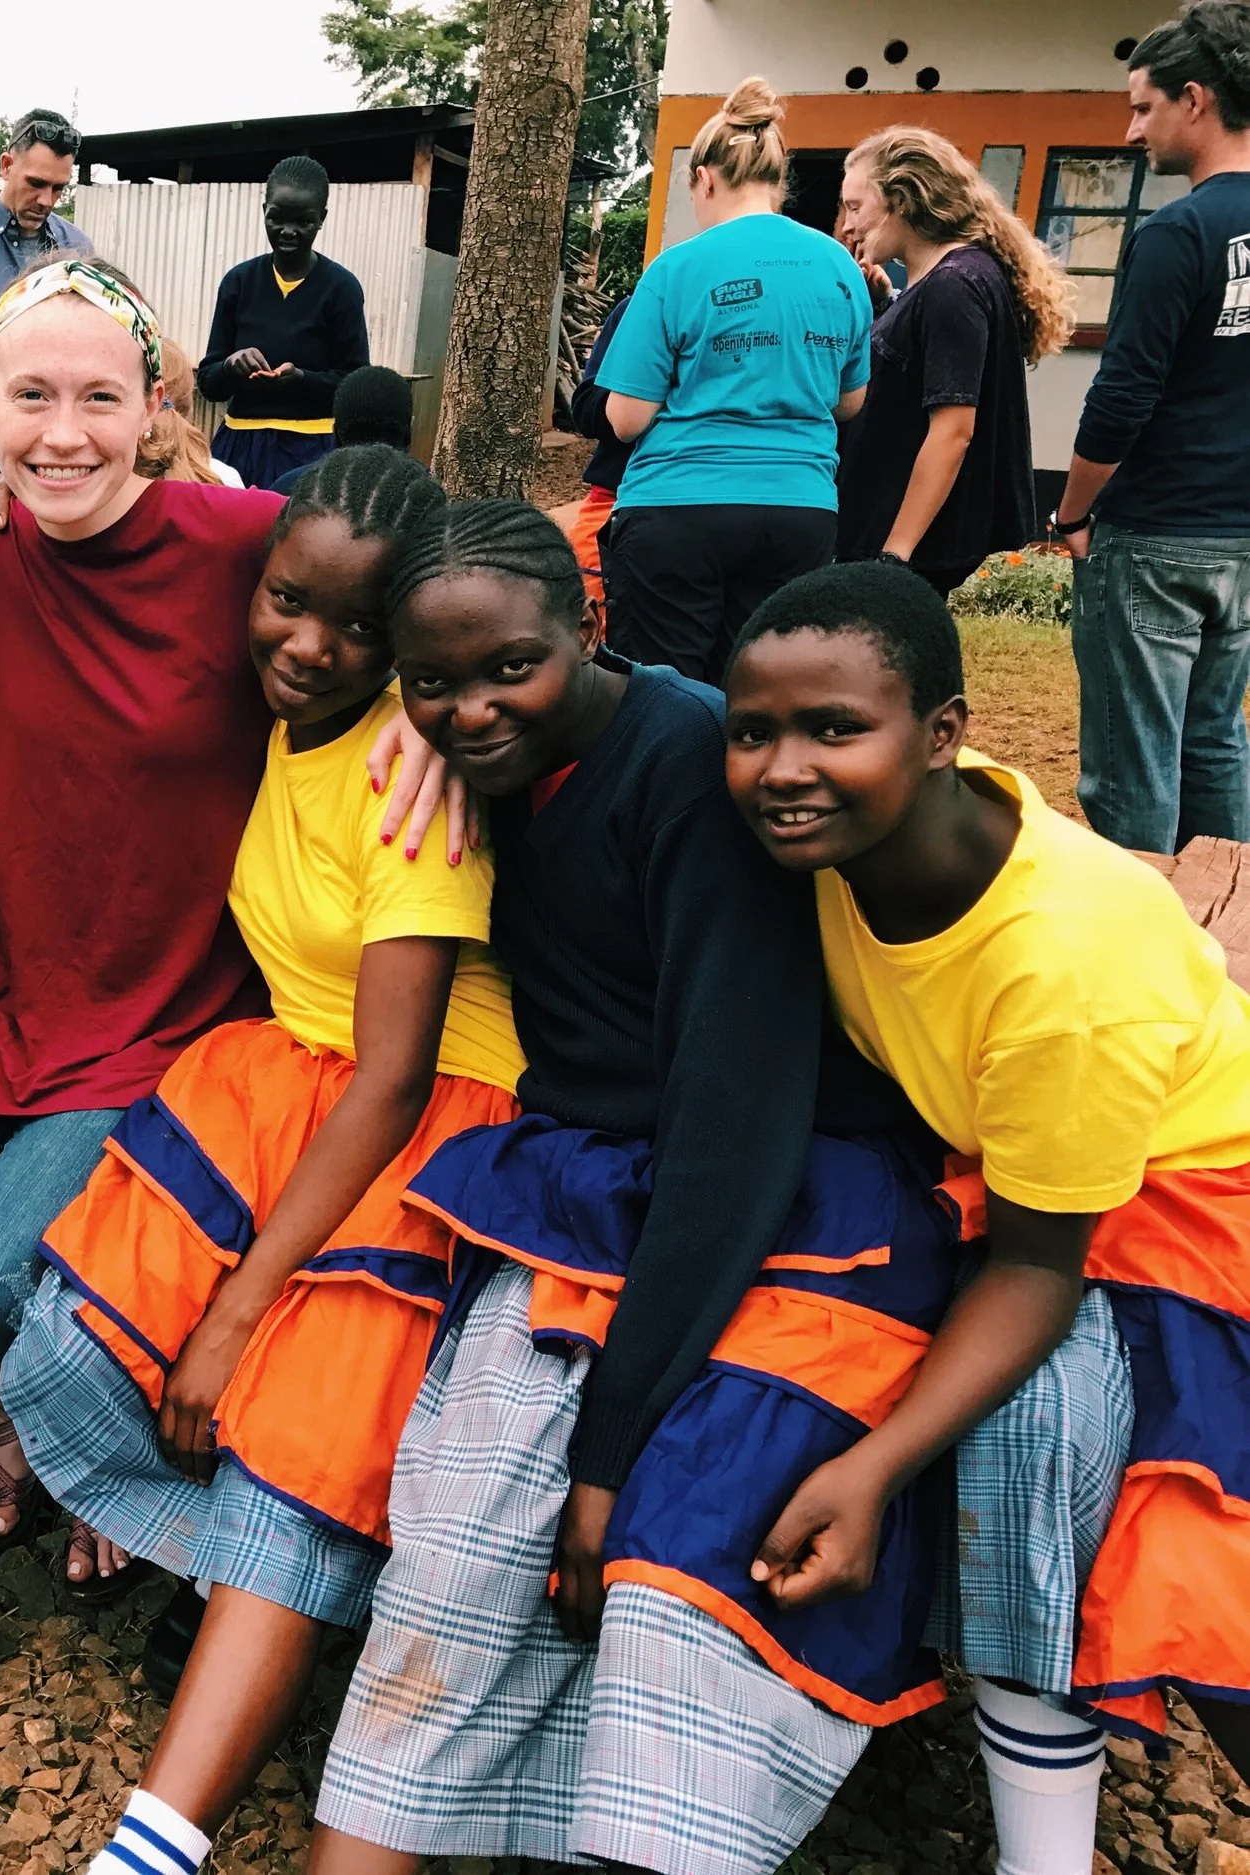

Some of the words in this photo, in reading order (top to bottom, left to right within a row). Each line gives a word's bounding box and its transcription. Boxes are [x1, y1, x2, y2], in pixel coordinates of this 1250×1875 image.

[755, 259, 799, 268] Courtesy
[715, 280, 756, 295] GIANT
[716, 289, 757, 304] EAGLE
[717, 303, 759, 315] ALTOONA
[712, 335, 751, 355] opening
[753, 332, 781, 347] minds.
